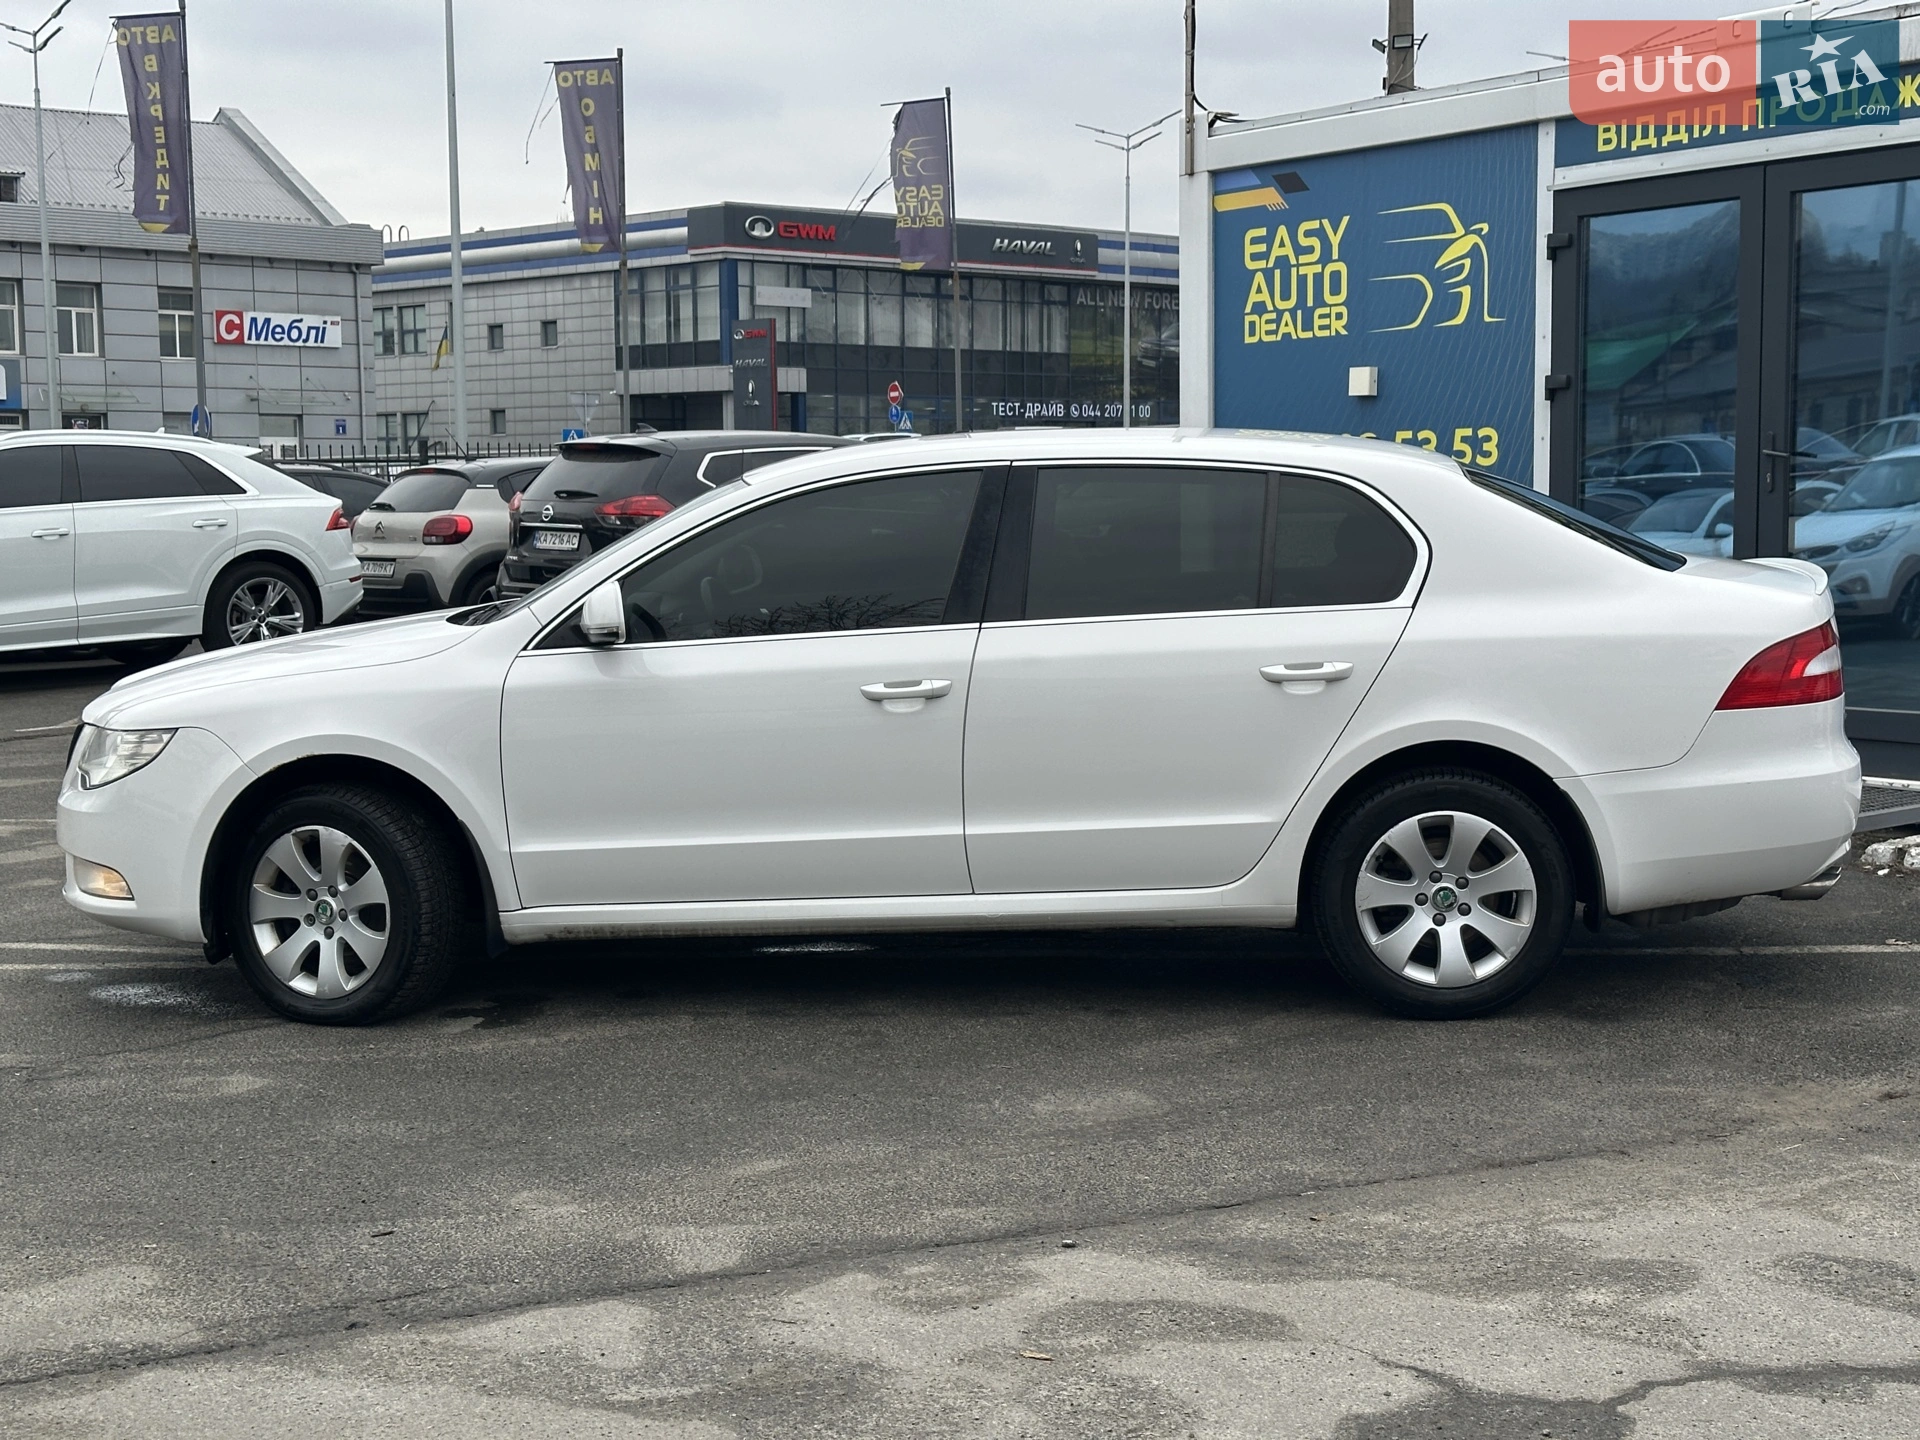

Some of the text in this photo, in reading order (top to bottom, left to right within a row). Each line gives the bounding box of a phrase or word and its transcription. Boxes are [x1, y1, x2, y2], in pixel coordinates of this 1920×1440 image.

[1597, 103, 1726, 152] ВІДДІЛ
[778, 221, 836, 241] GWM
[1244, 215, 1351, 270] EASY
[992, 238, 1057, 256] HAVAL
[1076, 287, 1105, 306] ALL
[1244, 261, 1348, 314] AUTO
[246, 316, 328, 344] Меблі
[1244, 305, 1348, 344] DEALER
[735, 358, 768, 368] HAVAL
[991, 402, 1065, 419] ТЕСТ-ДРАЙВ
[1082, 403, 1101, 417] 044
[1104, 404, 1123, 417] 207
[1138, 405, 1151, 418] 00
[1450, 427, 1499, 467] 53
